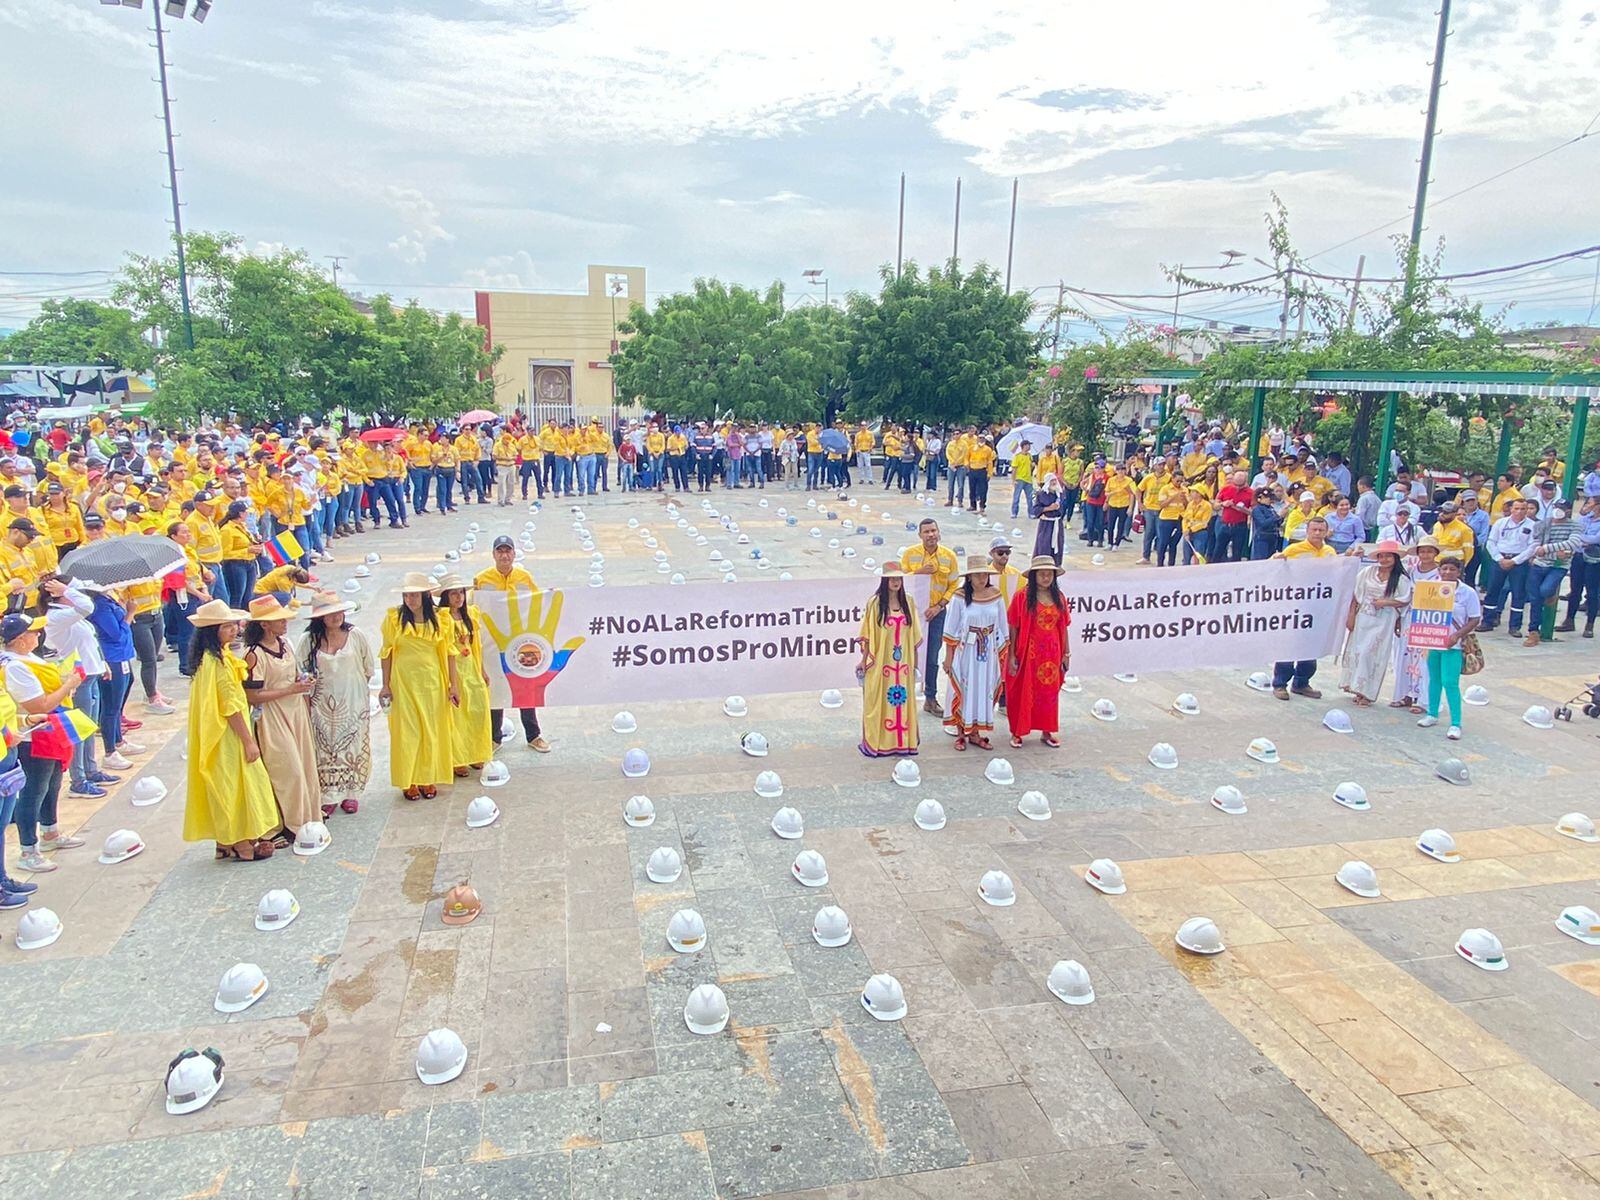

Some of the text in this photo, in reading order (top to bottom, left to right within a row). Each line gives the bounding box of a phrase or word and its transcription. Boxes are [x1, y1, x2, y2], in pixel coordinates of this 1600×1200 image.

[1067, 583, 1333, 613] #NoALaReformaTributaria
[589, 605, 864, 635] #NoALaReformaTribut
[1082, 609, 1314, 643] #SomosProMineria
